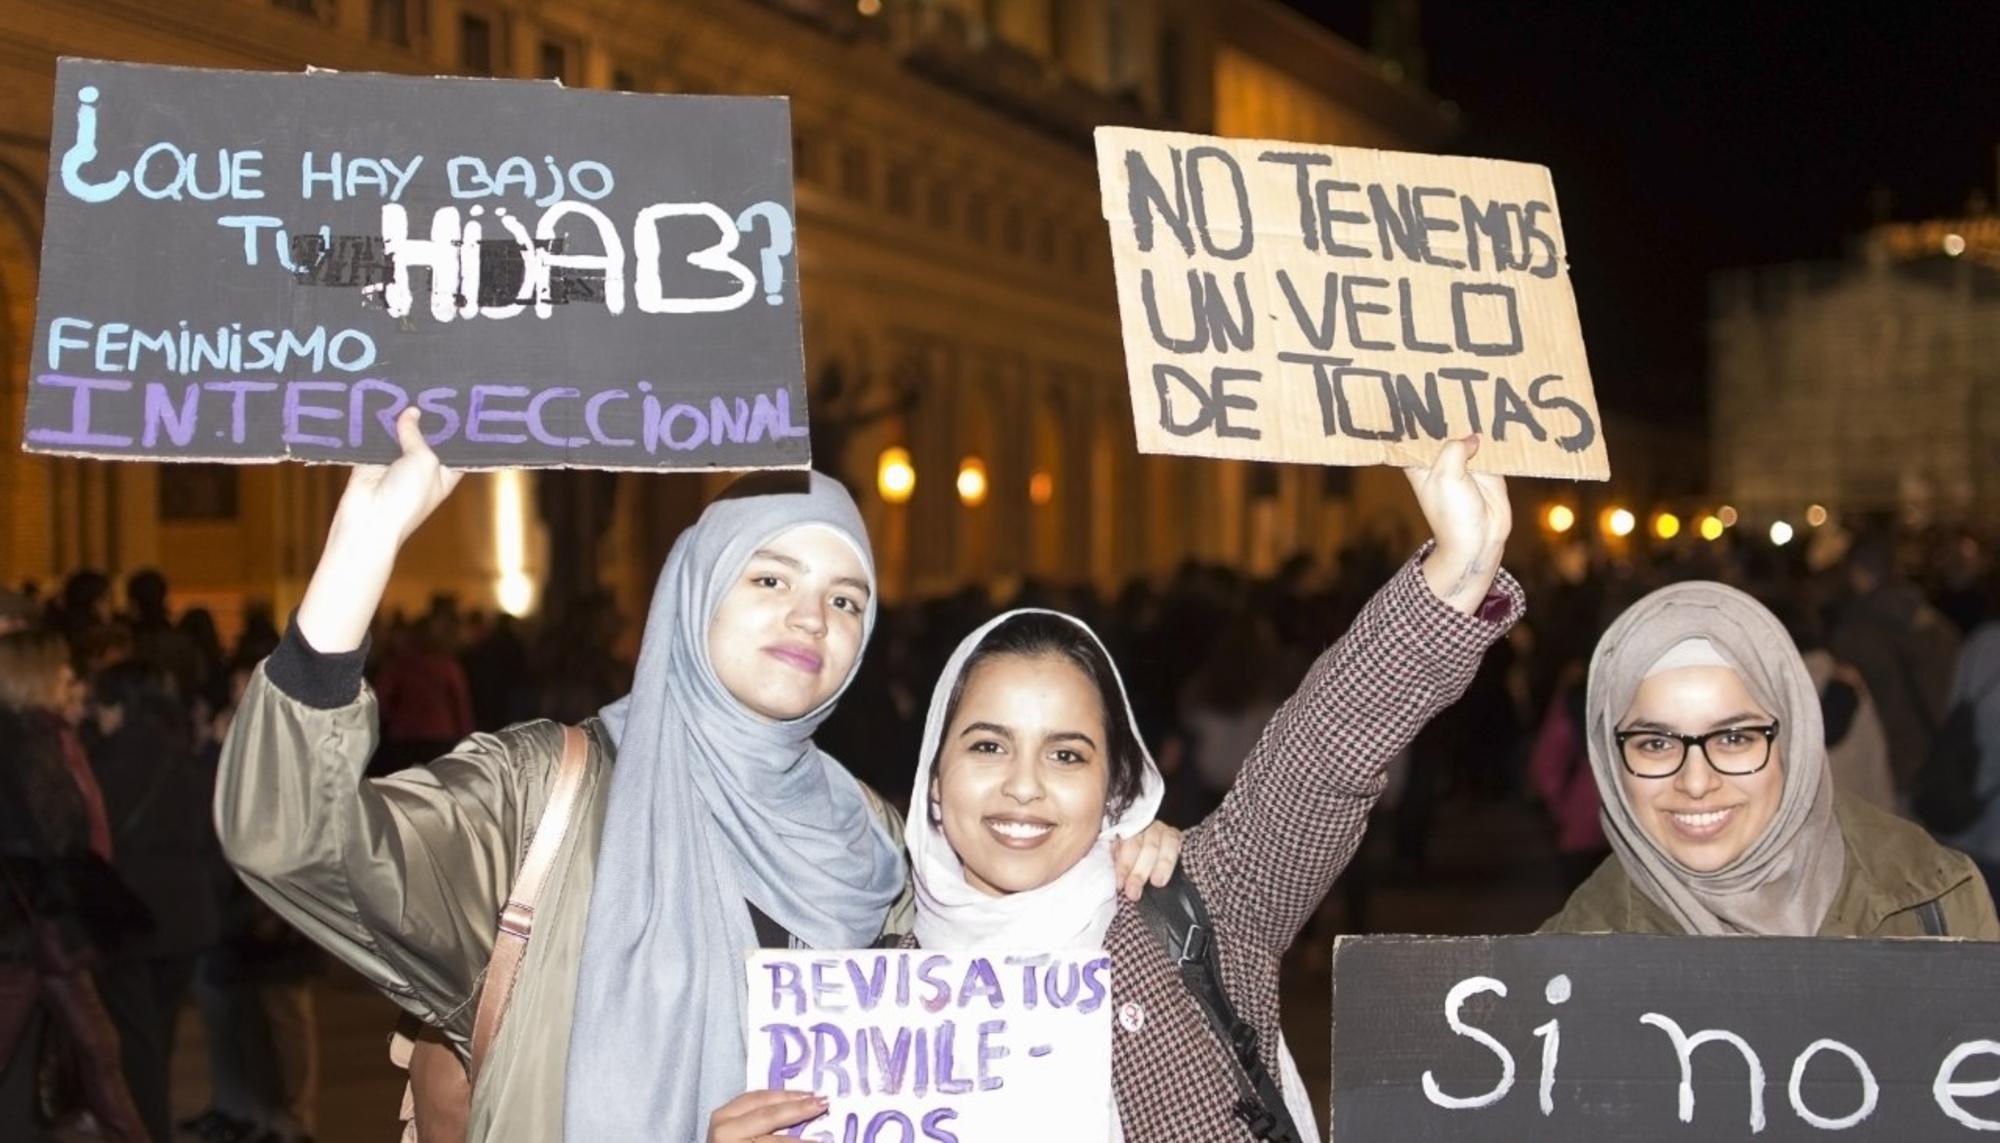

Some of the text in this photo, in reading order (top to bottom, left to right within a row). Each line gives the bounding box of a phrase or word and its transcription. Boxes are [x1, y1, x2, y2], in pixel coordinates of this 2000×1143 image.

[302, 151, 423, 202] HAY
[1125, 146, 1560, 279] NO TENEMOS
[1141, 268, 1524, 356] UN VELO
[1152, 351, 1596, 453] DE TONTAS
[1421, 973, 1572, 1116] Si
[1639, 1011, 1879, 1134] no
